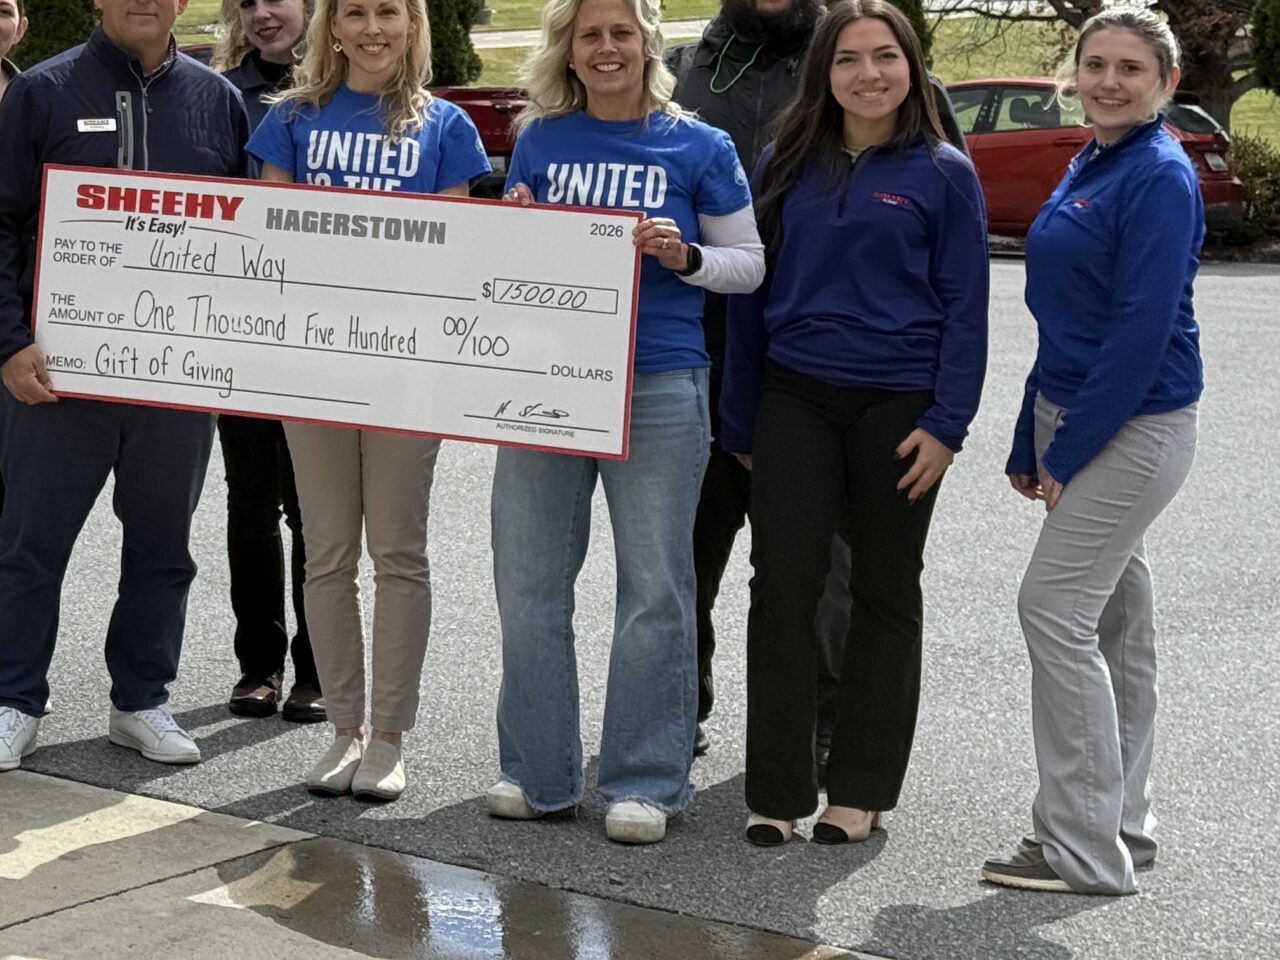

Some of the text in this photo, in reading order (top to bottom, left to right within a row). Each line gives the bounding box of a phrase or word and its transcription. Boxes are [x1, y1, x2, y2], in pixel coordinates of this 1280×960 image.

[307, 130, 420, 177] UNITED
[547, 162, 667, 209] UNITED
[77, 185, 244, 221] SHEEHY
[125, 216, 187, 238] It's Easy!
[266, 208, 447, 244] HAGERSTOWN
[590, 224, 624, 238] 2026
[54, 238, 123, 254] PAY TO THE
[53, 252, 117, 267] ORDER OF
[149, 239, 285, 294] United Way
[50, 293, 75, 306] THE
[482, 282, 491, 300] $
[499, 283, 587, 308] 1500.00
[48, 308, 125, 325] AMOUNT OF
[134, 290, 175, 331] One
[187, 295, 286, 341] Thousand
[305, 313, 335, 346] Five
[348, 315, 417, 355] Hundred
[45, 355, 86, 369] MEMO:
[95, 343, 233, 398] Gift of Giving
[551, 365, 613, 382] DOLLARS
[496, 423, 576, 438] AUTHORIZED SIGNATURE
